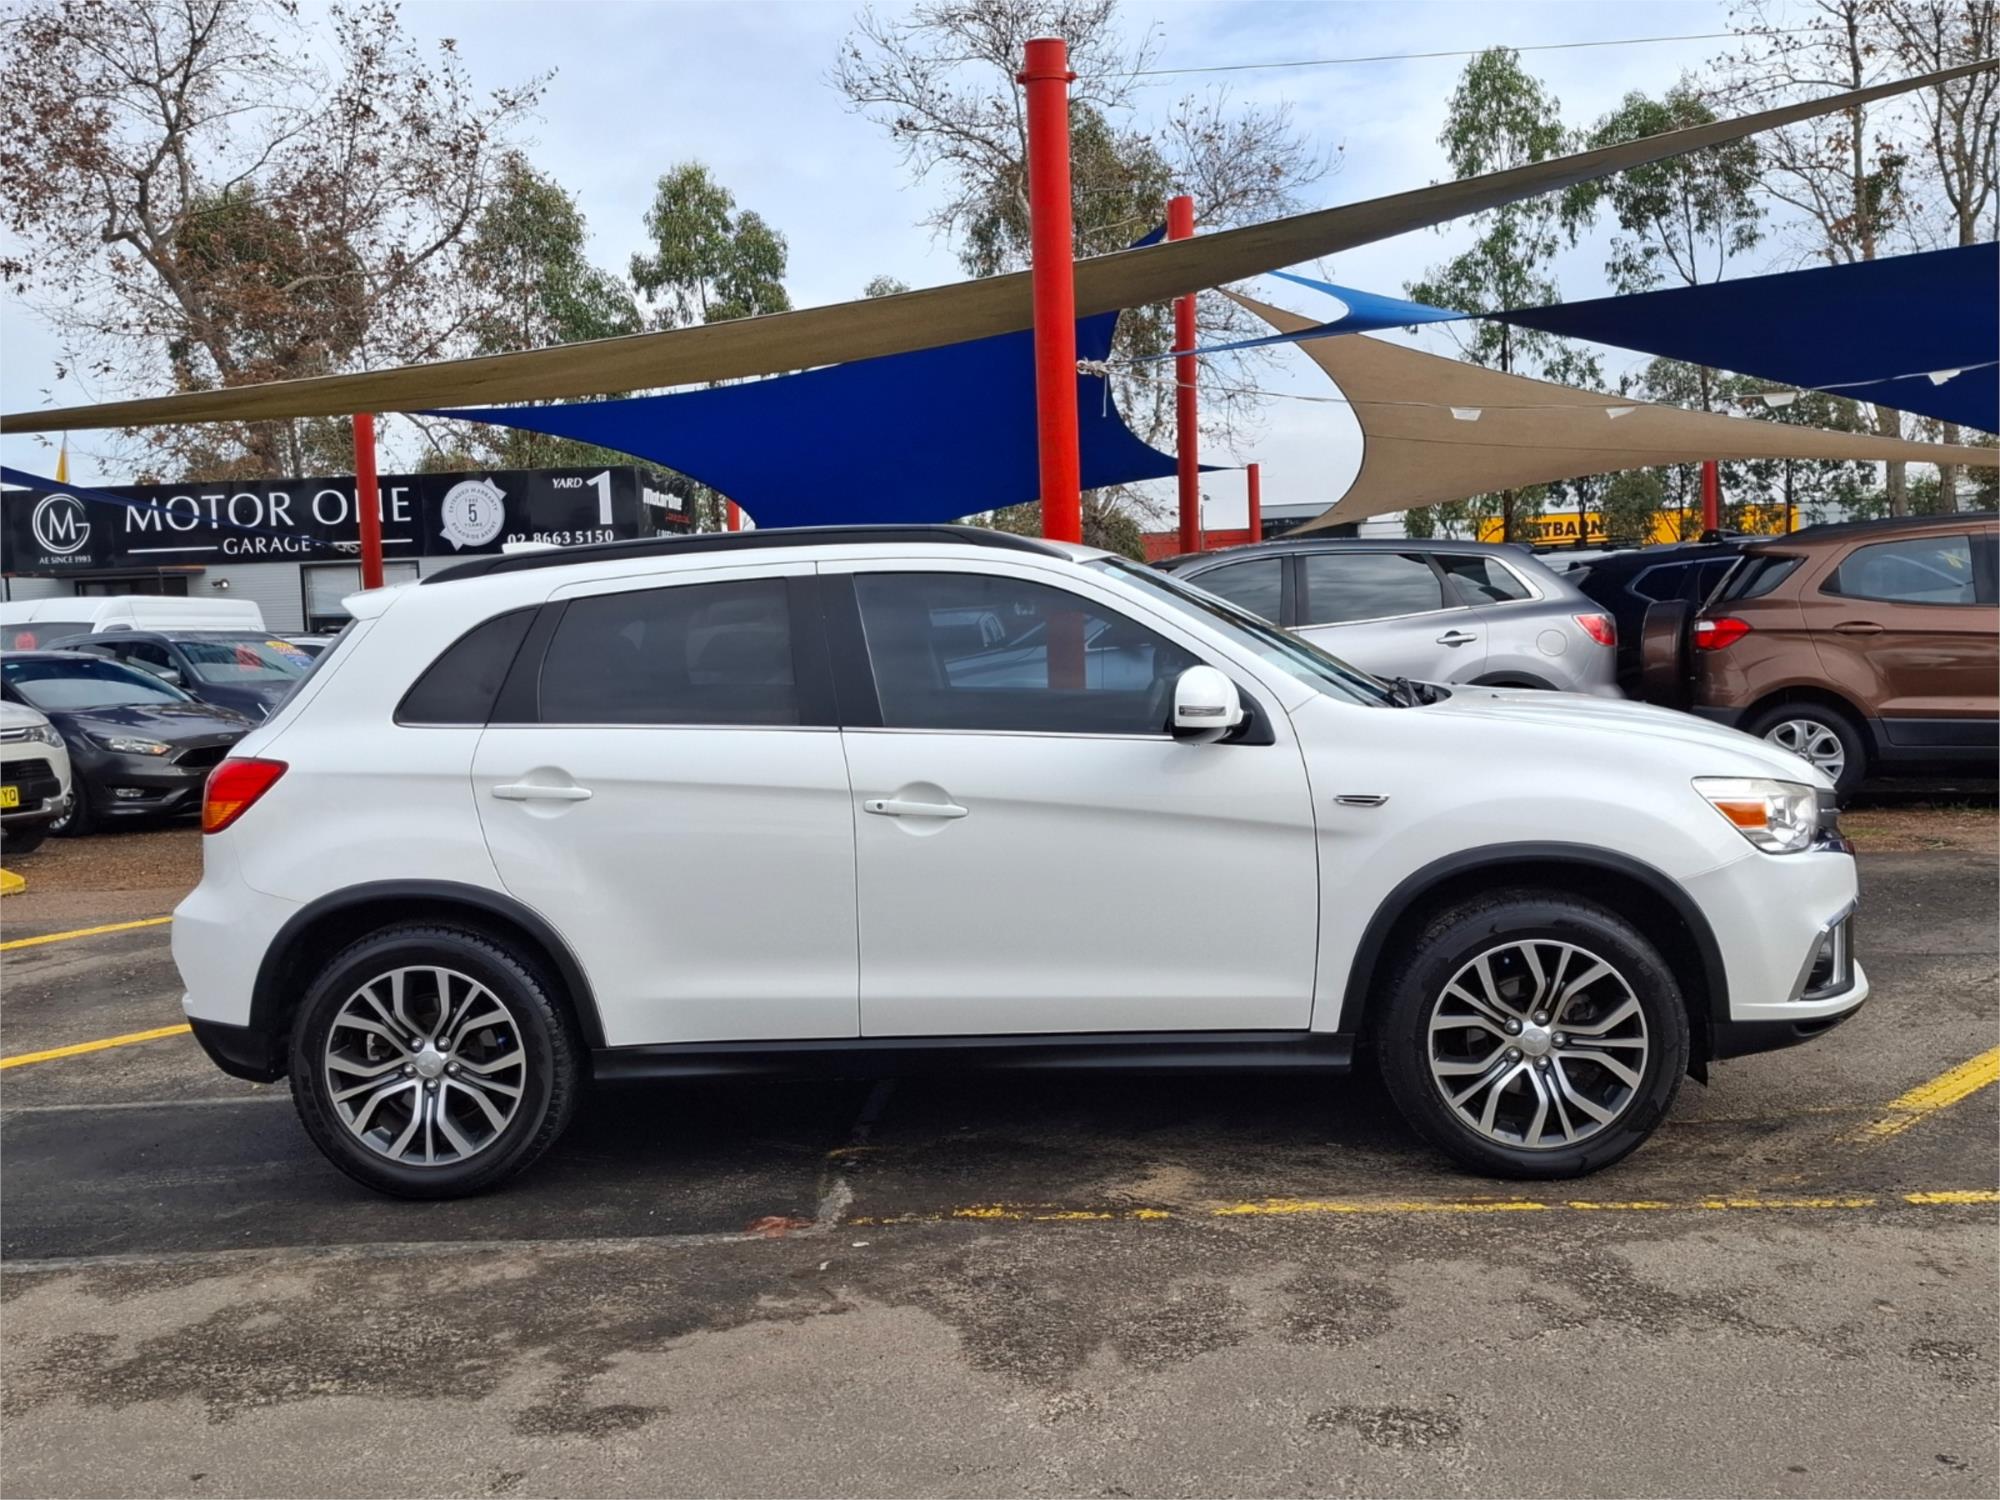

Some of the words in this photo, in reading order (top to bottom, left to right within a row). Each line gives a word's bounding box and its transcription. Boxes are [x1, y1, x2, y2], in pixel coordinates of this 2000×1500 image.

[552, 477, 583, 489] YARD
[586, 470, 613, 525] 1
[125, 492, 295, 533] MOTOR
[468, 503, 478, 523] 5
[223, 535, 311, 554] GARAGE
[507, 533, 526, 543] 02
[533, 531, 571, 545] 8663
[575, 529, 614, 544] 5150
[50, 555, 73, 564] SINCE
